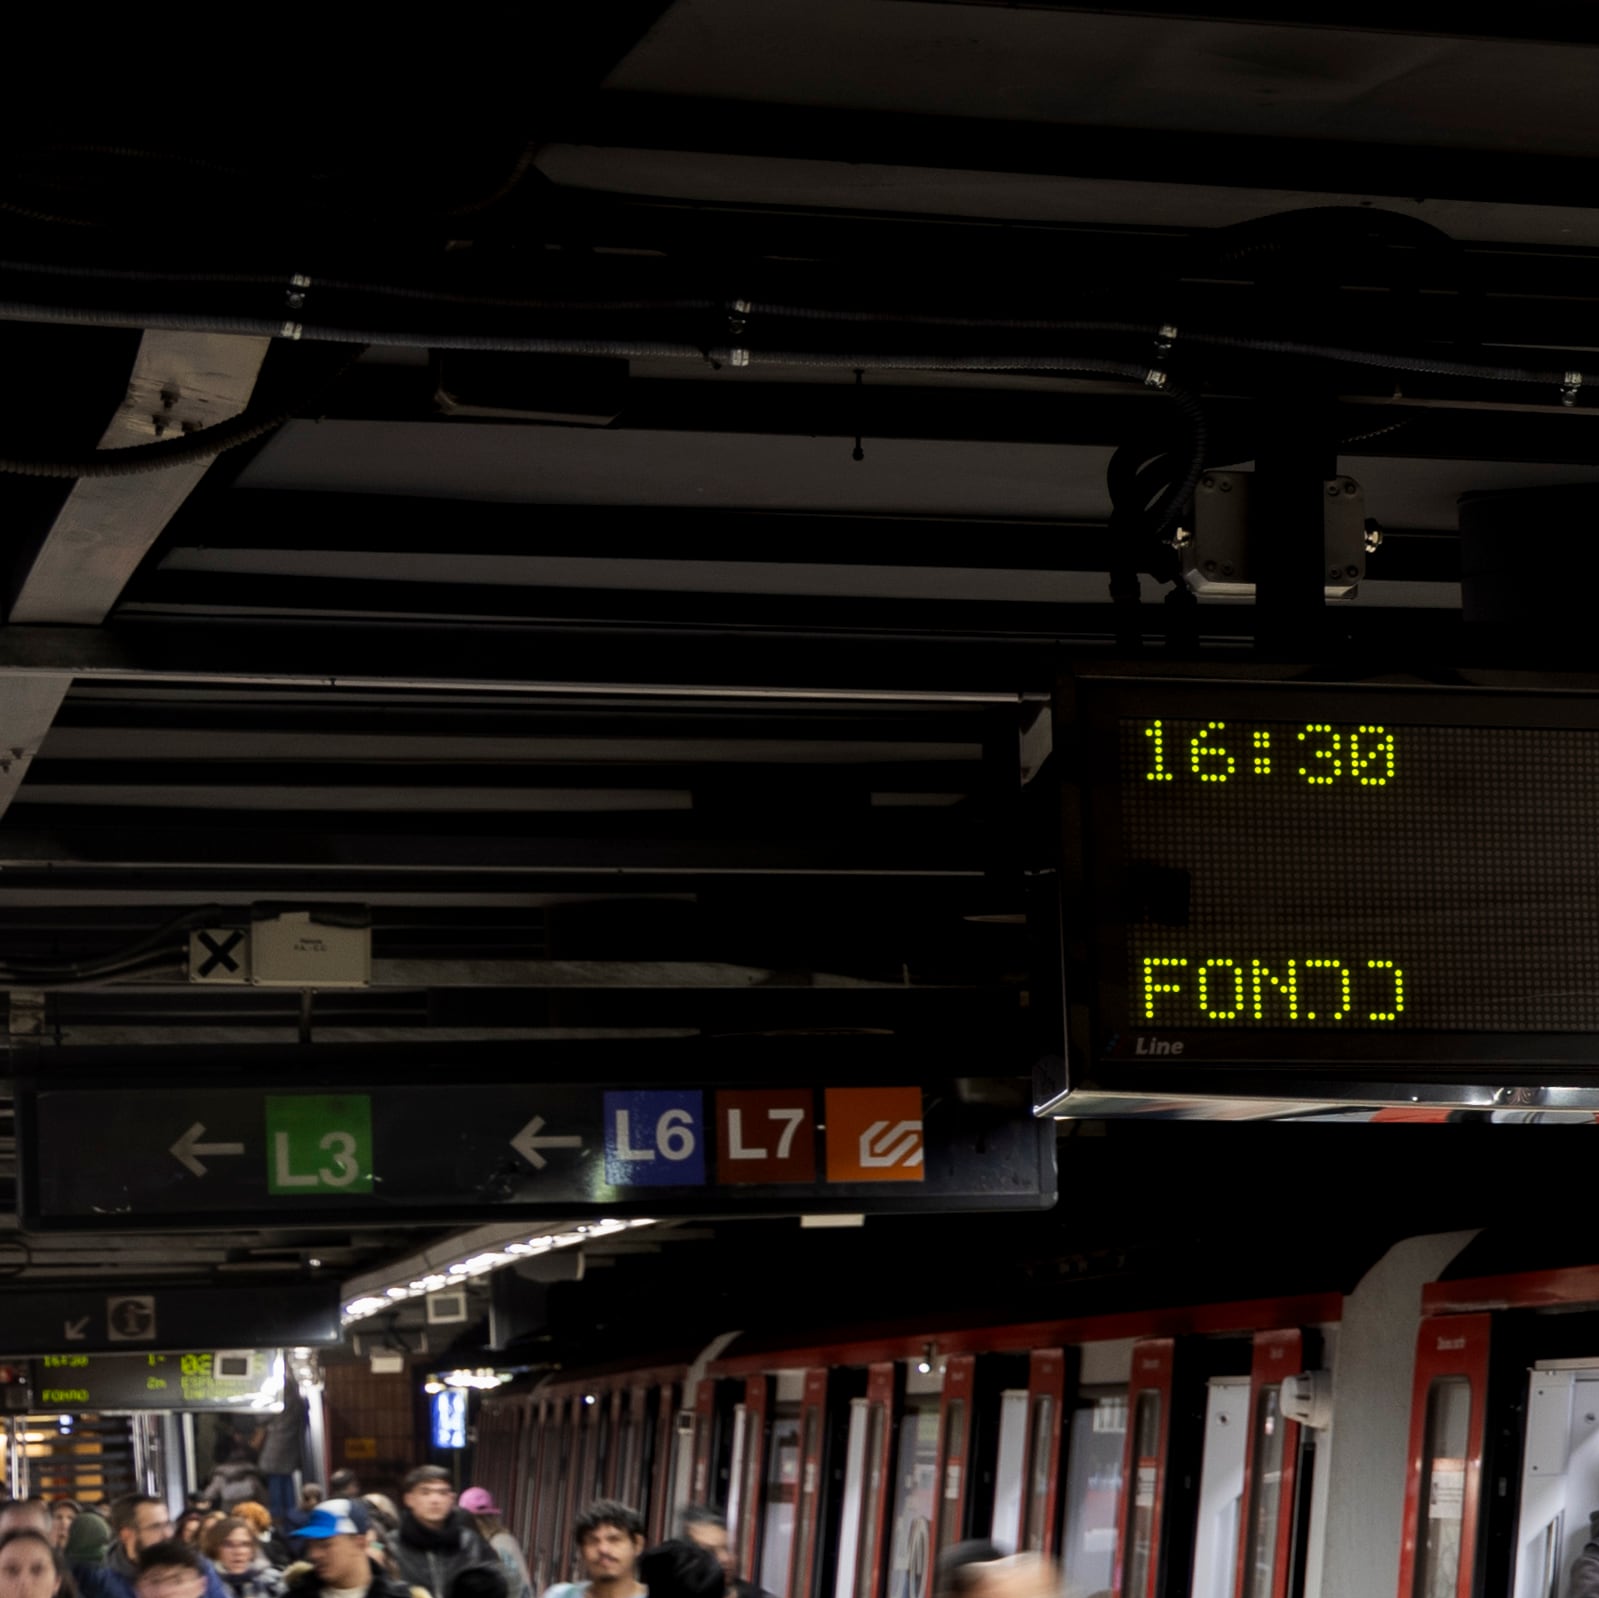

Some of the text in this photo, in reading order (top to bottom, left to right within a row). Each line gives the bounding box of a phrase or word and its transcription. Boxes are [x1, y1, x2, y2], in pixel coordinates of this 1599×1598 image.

[1144, 719, 1395, 785] 16:30
[1136, 1037, 1184, 1055] Line
[274, 1131, 360, 1188] L3
[616, 1108, 804, 1161] L6 L7
